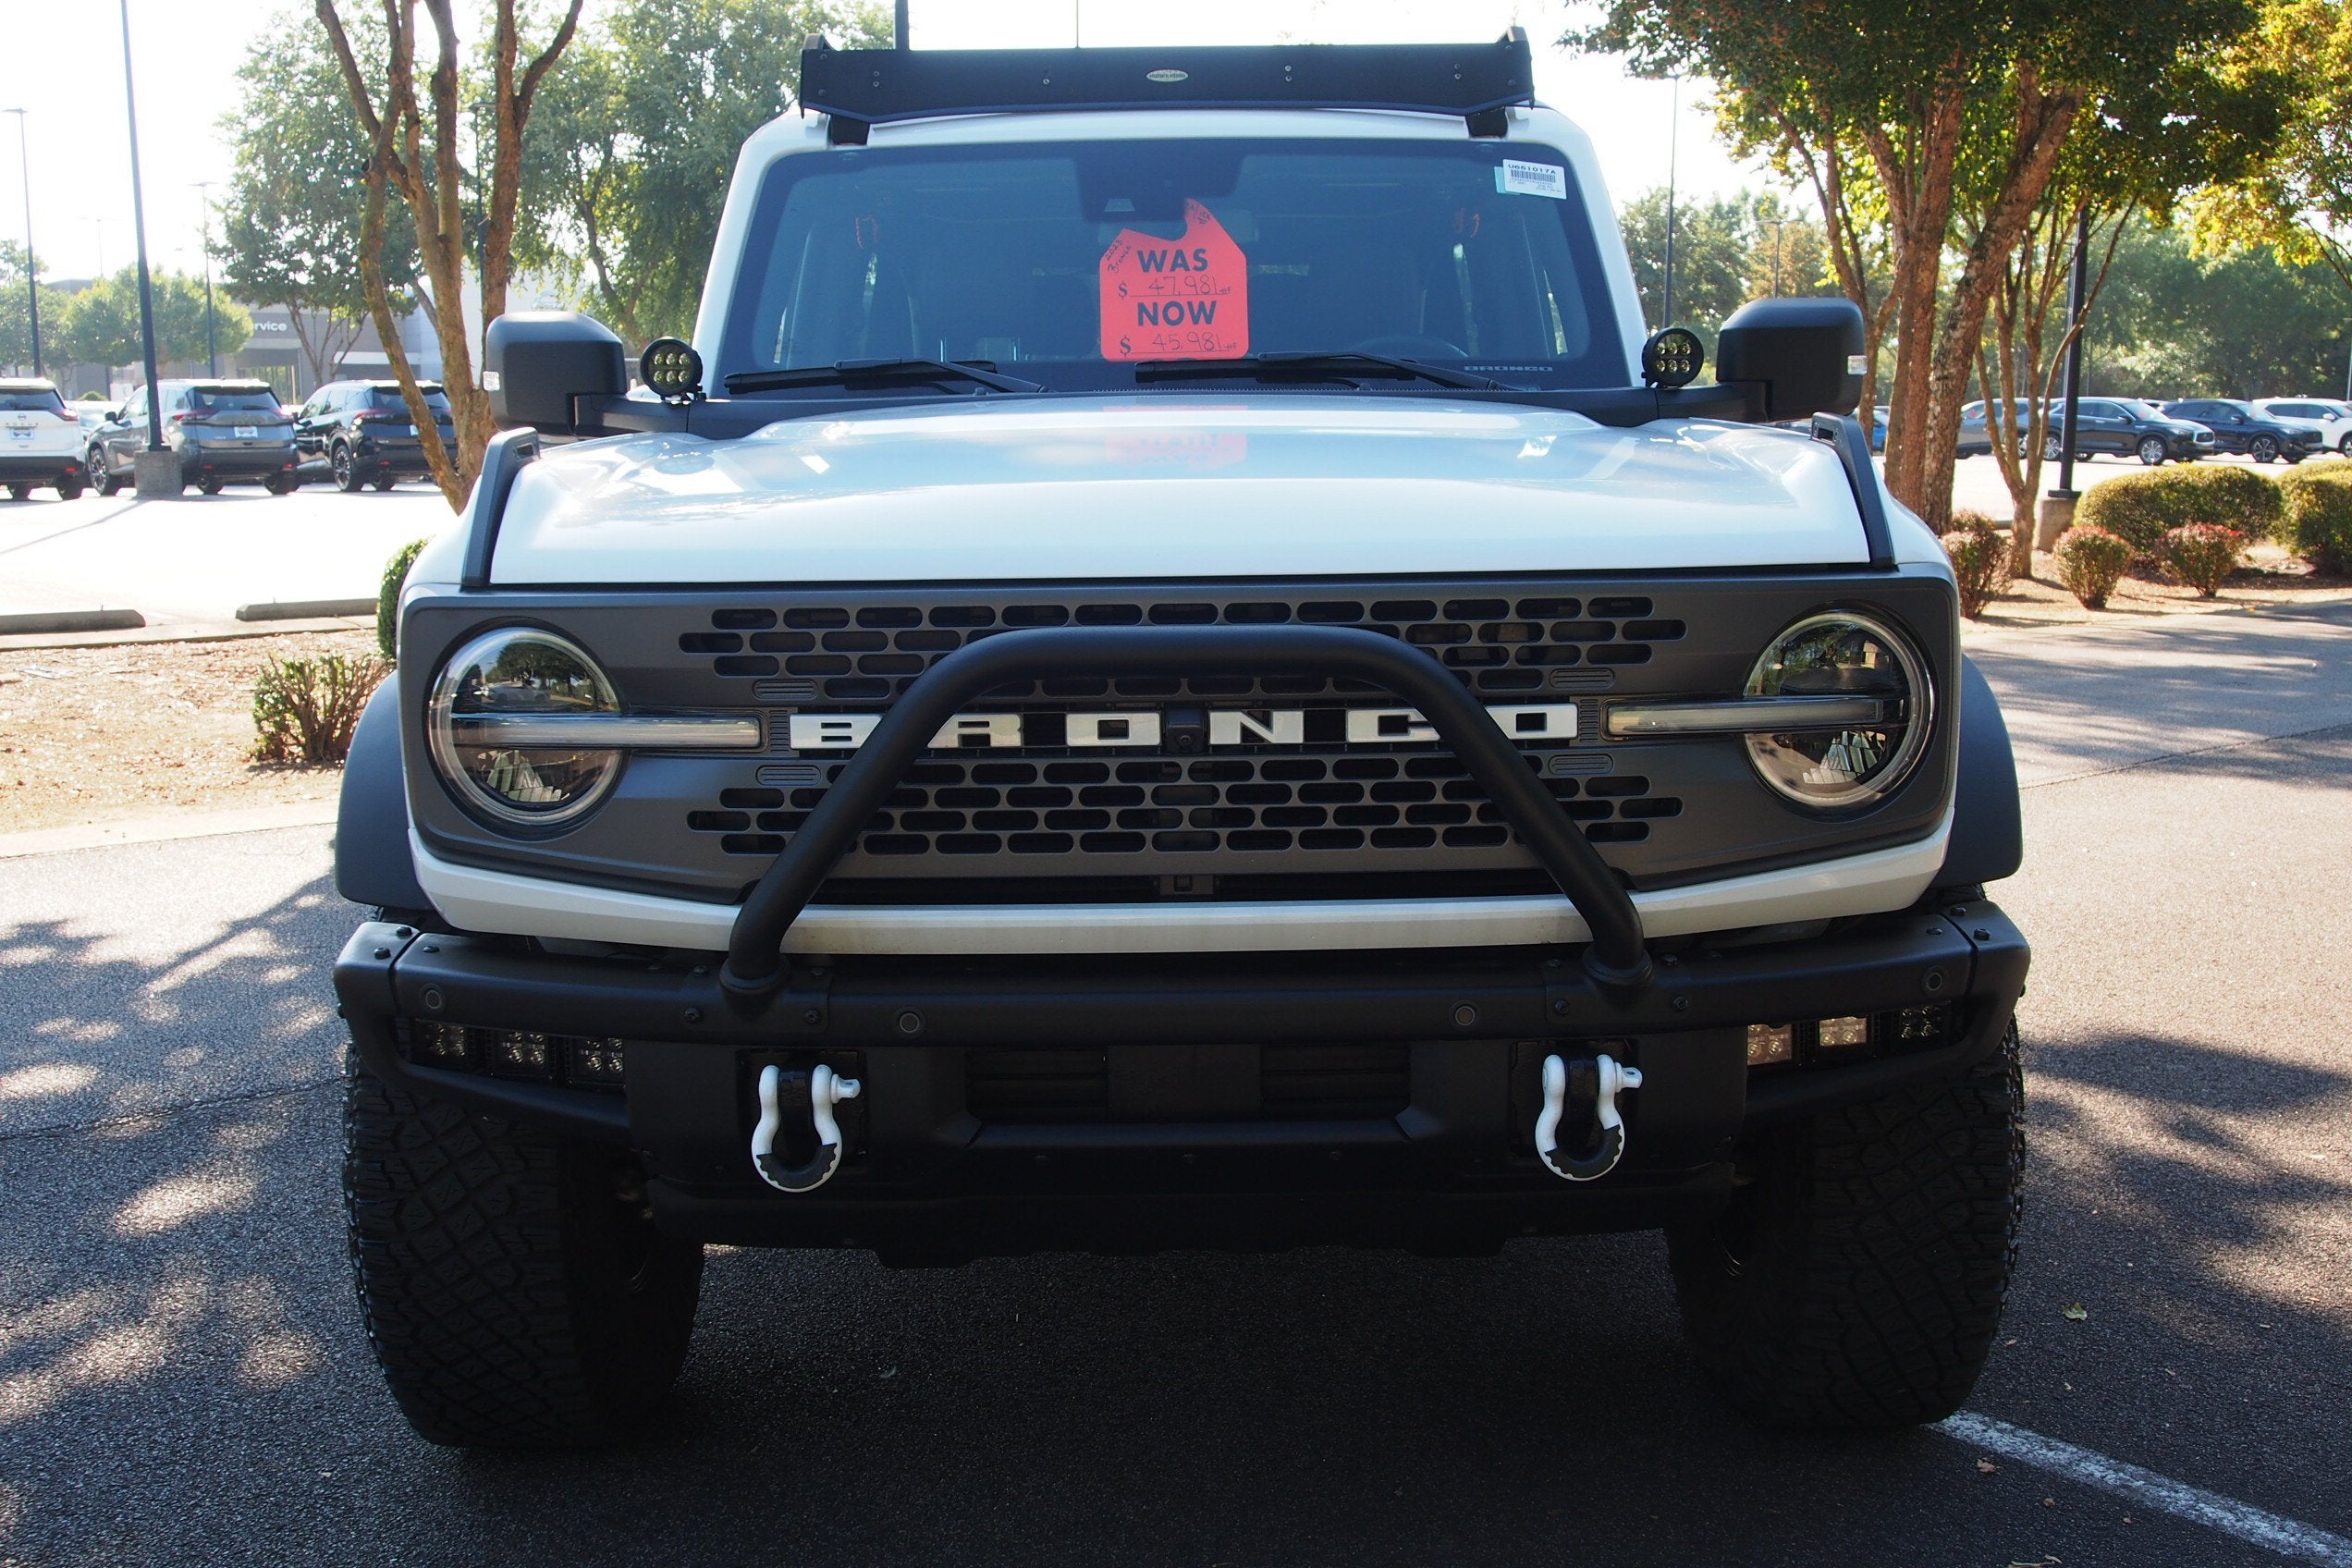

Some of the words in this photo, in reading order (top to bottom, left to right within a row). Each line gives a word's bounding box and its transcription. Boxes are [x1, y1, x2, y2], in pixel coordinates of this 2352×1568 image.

[1137, 249, 1208, 273] WAS
[1118, 281, 1128, 300] $
[1137, 300, 1217, 326] NOW
[253, 321, 287, 331] rvice
[1120, 335, 1132, 358] $
